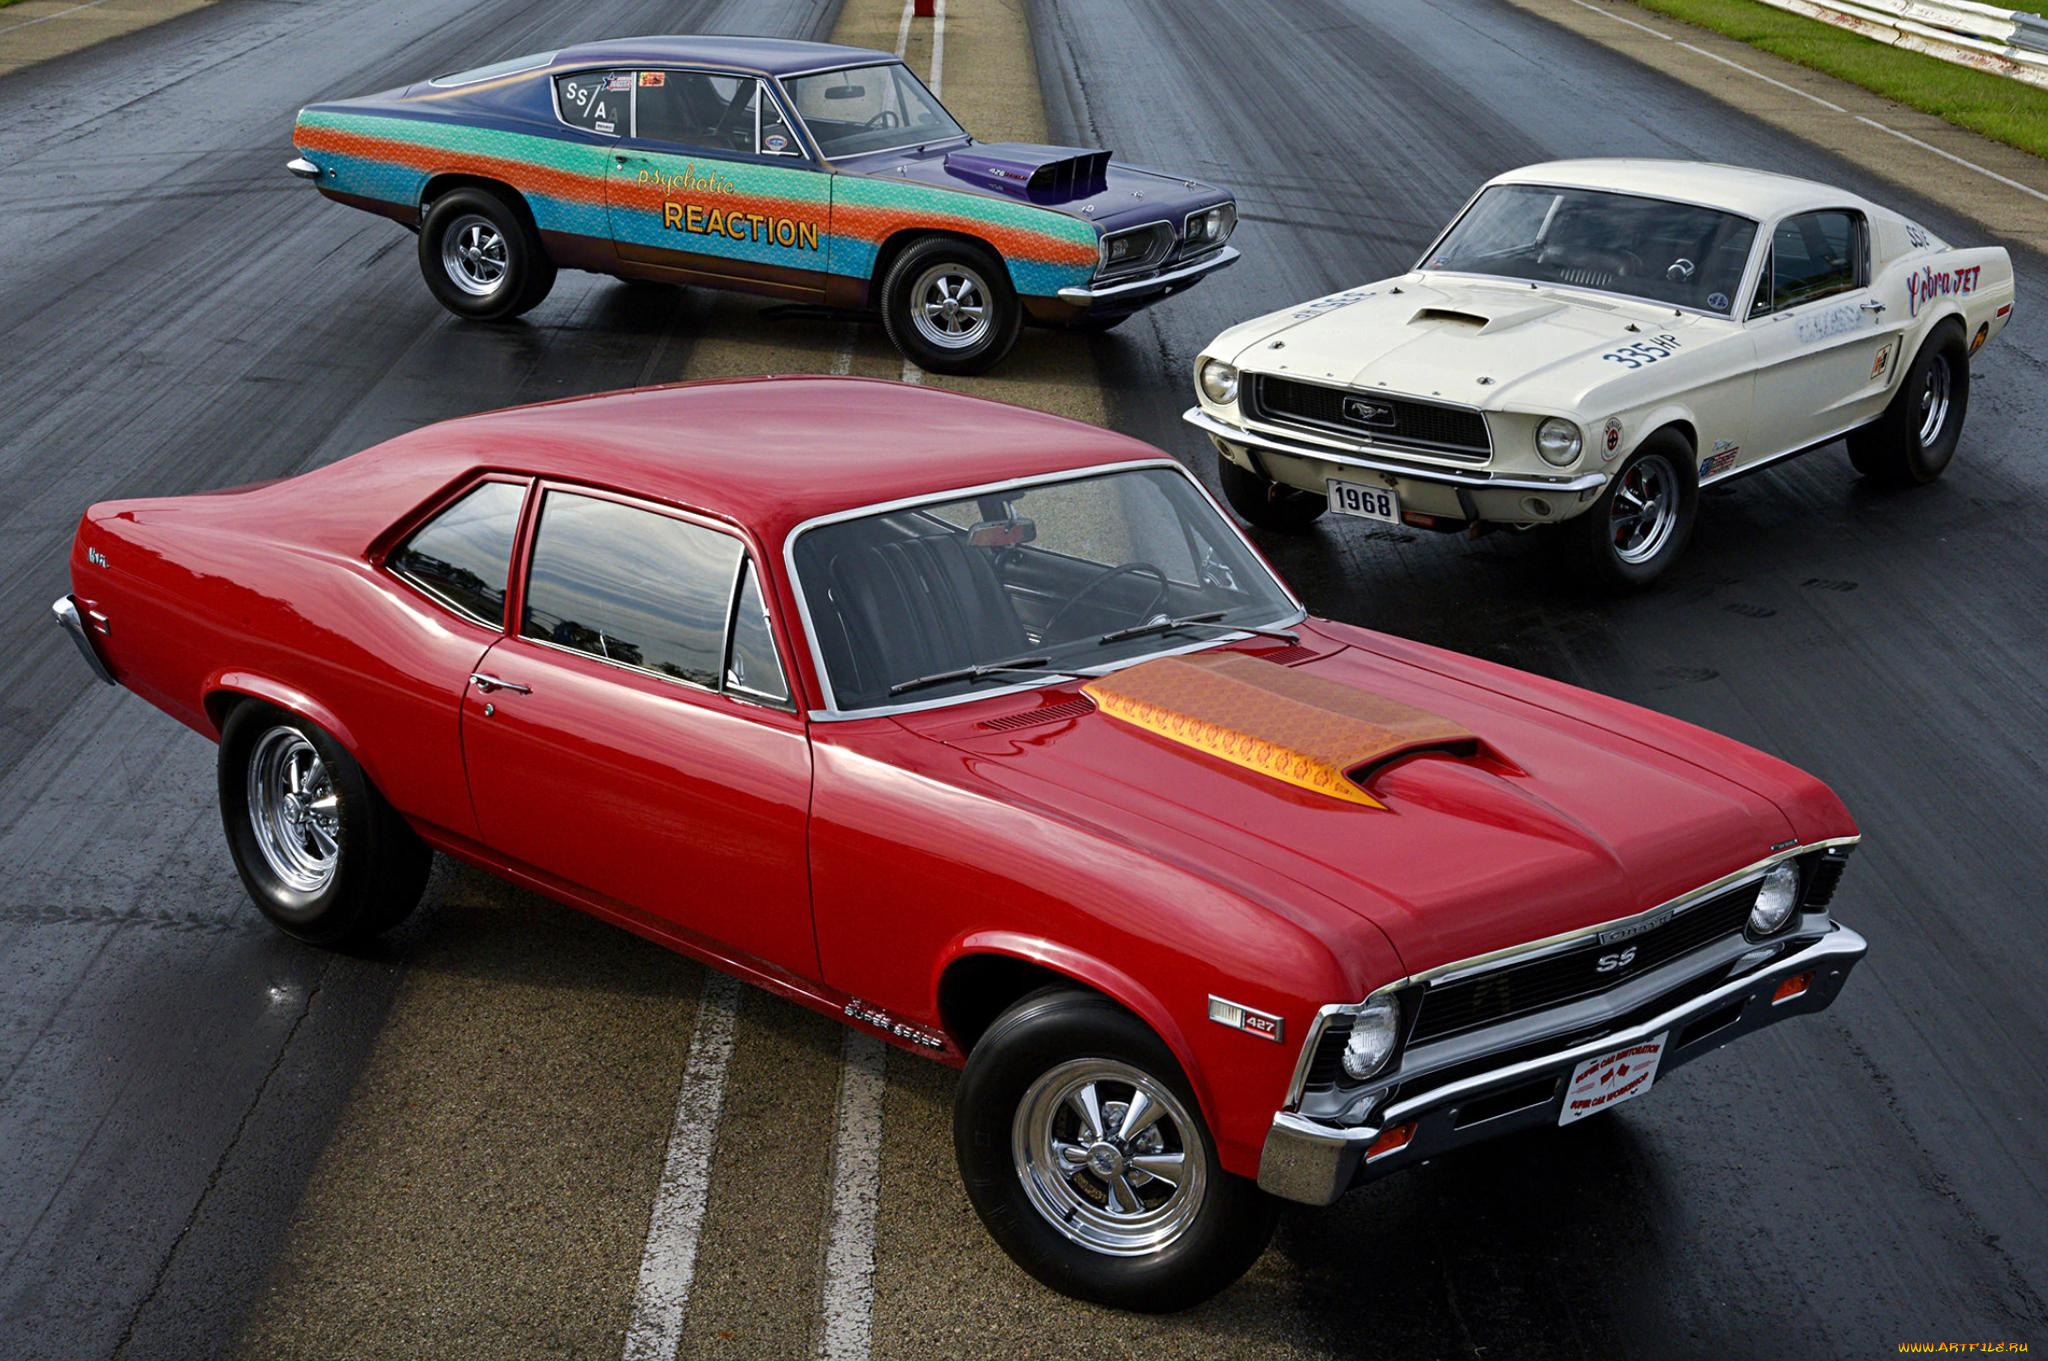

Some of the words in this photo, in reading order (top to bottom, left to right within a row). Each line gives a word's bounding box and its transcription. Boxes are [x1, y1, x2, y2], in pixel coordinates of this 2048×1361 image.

[566, 82, 606, 118] SS/A
[663, 200, 819, 251] REACTION
[1906, 265, 1951, 319] Cobra
[1953, 264, 1981, 295] JET
[1335, 486, 1391, 517] 1968
[1597, 946, 1637, 972] SS
[844, 1005, 889, 1030] SUPER
[1246, 1016, 1275, 1032] 427
